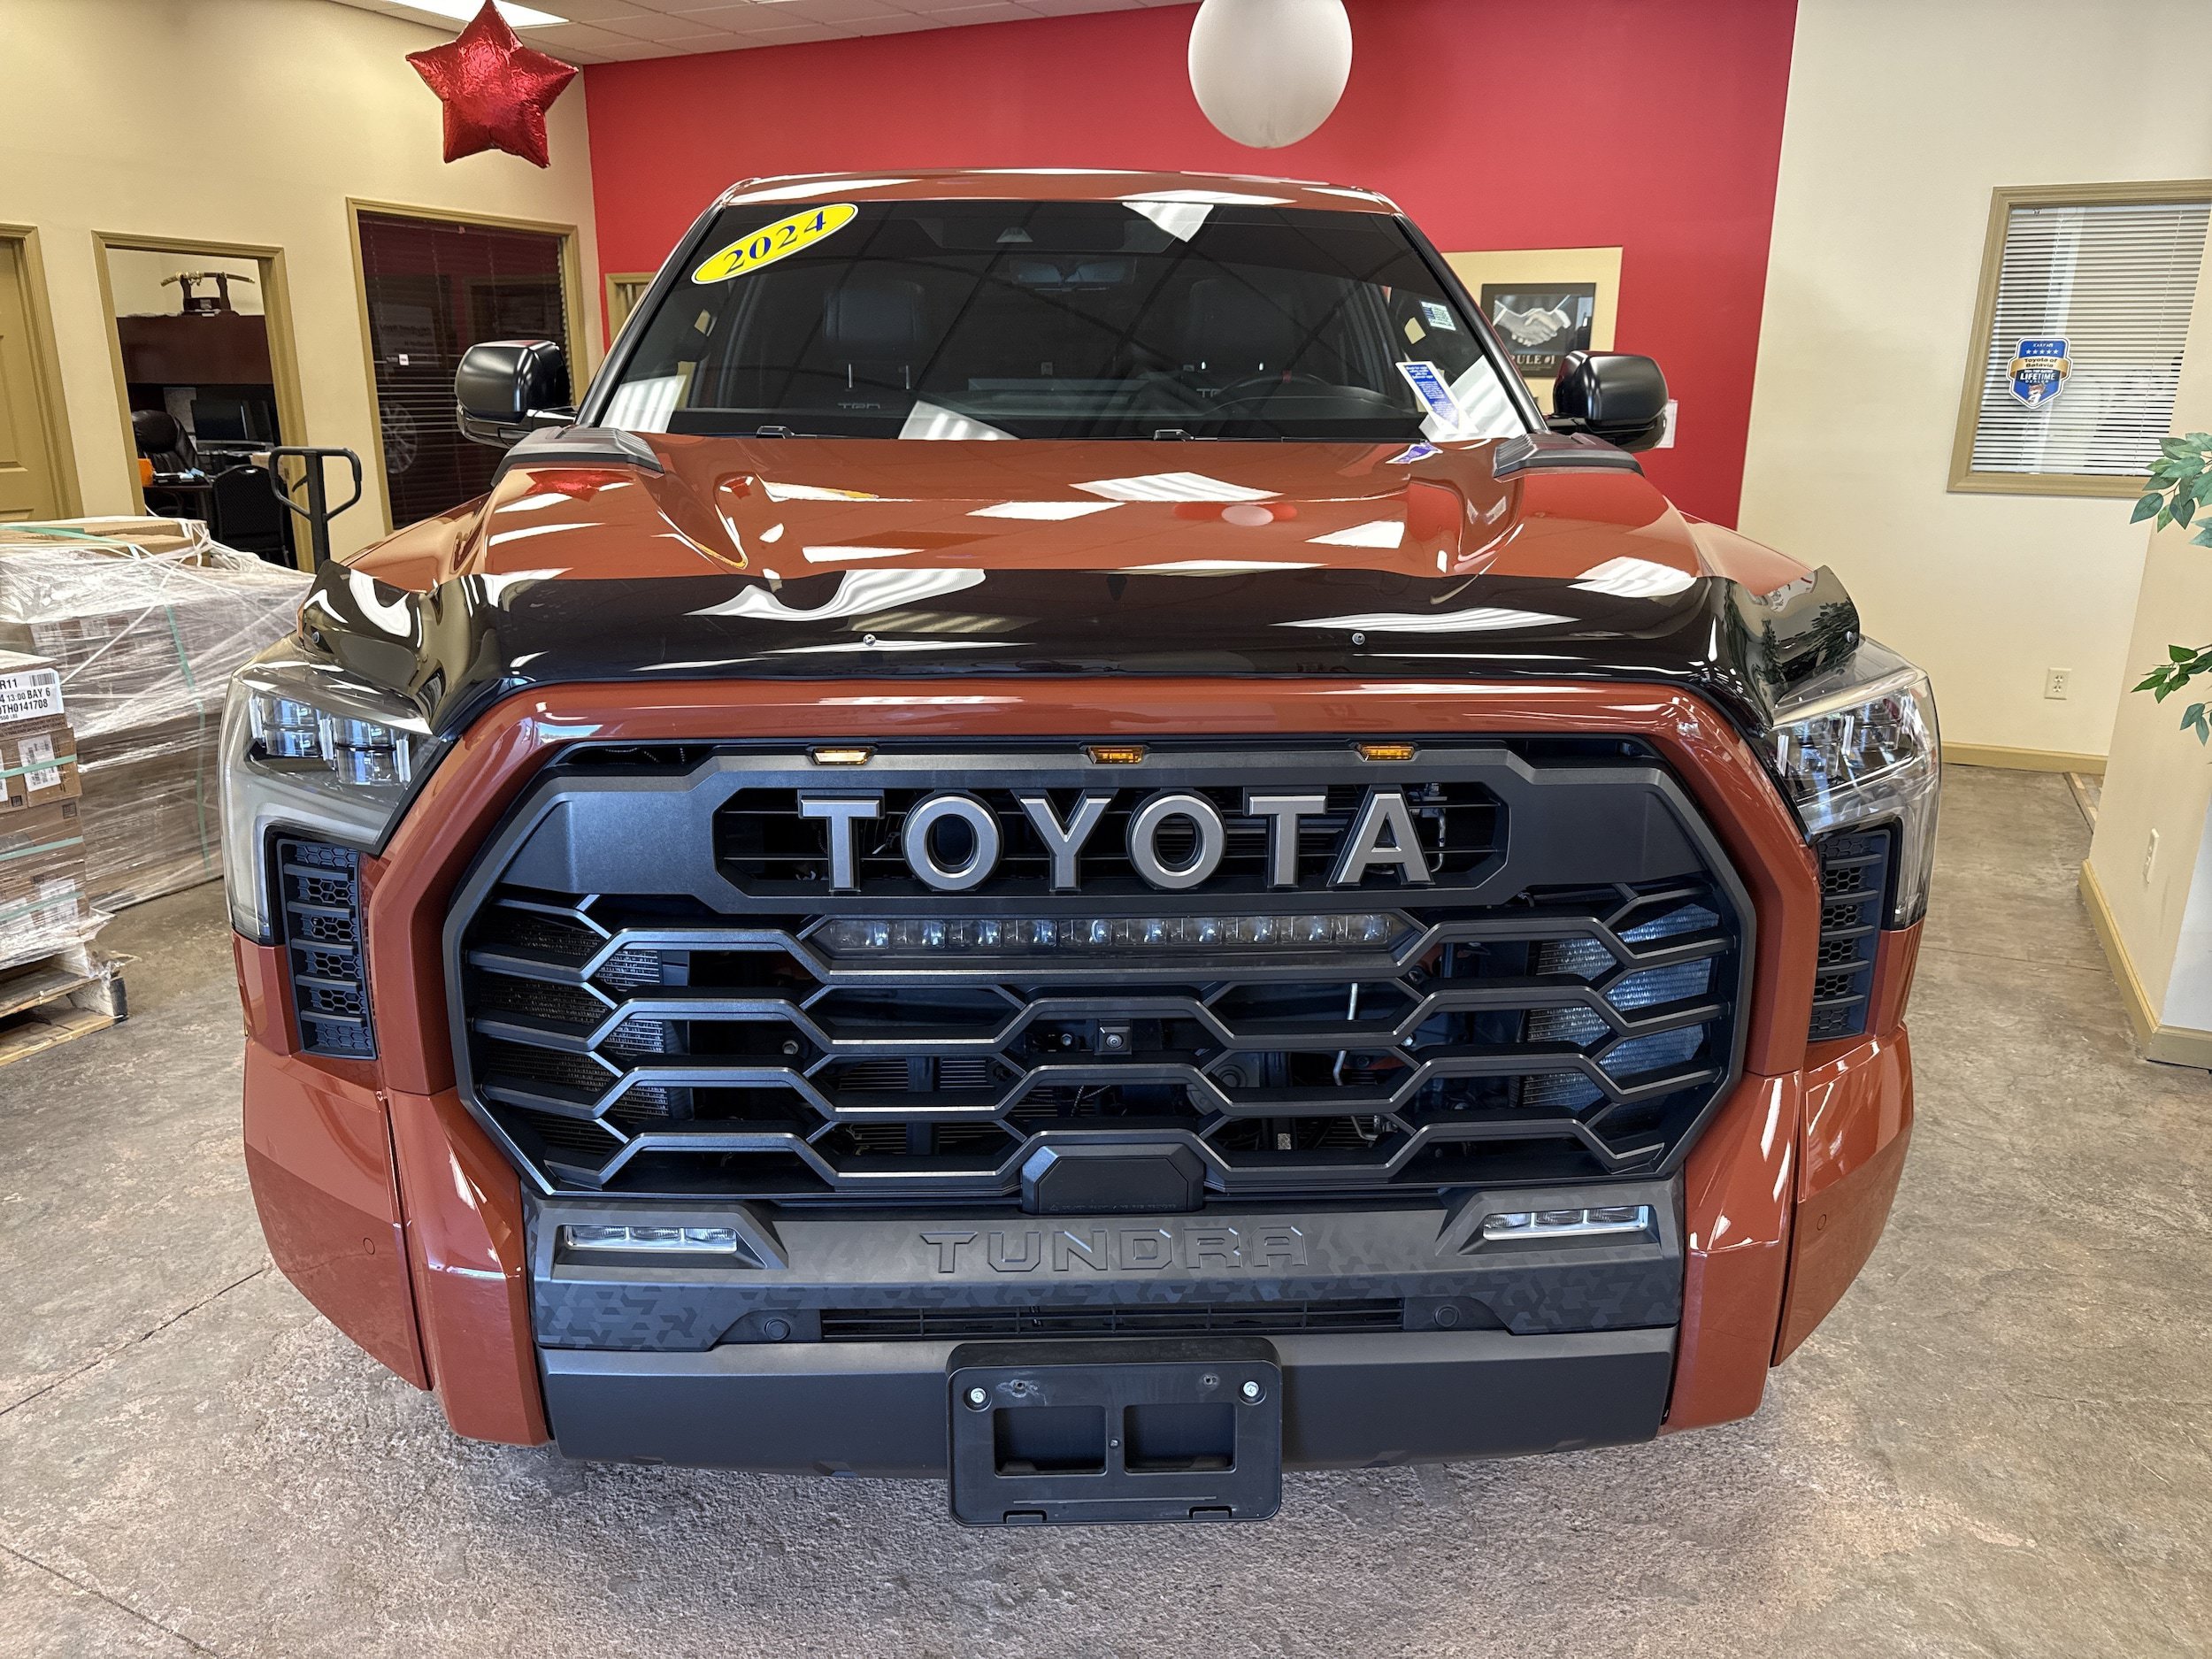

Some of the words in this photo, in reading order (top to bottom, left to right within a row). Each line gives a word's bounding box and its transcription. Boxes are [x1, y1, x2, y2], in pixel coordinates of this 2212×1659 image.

[724, 211, 826, 275] 2024
[7, 692, 26, 703] 13:00
[27, 687, 43, 700] BAY
[45, 687, 51, 697] 6
[801, 794, 1432, 890] TOYOTA
[919, 1226, 1309, 1274] TUNDRA
